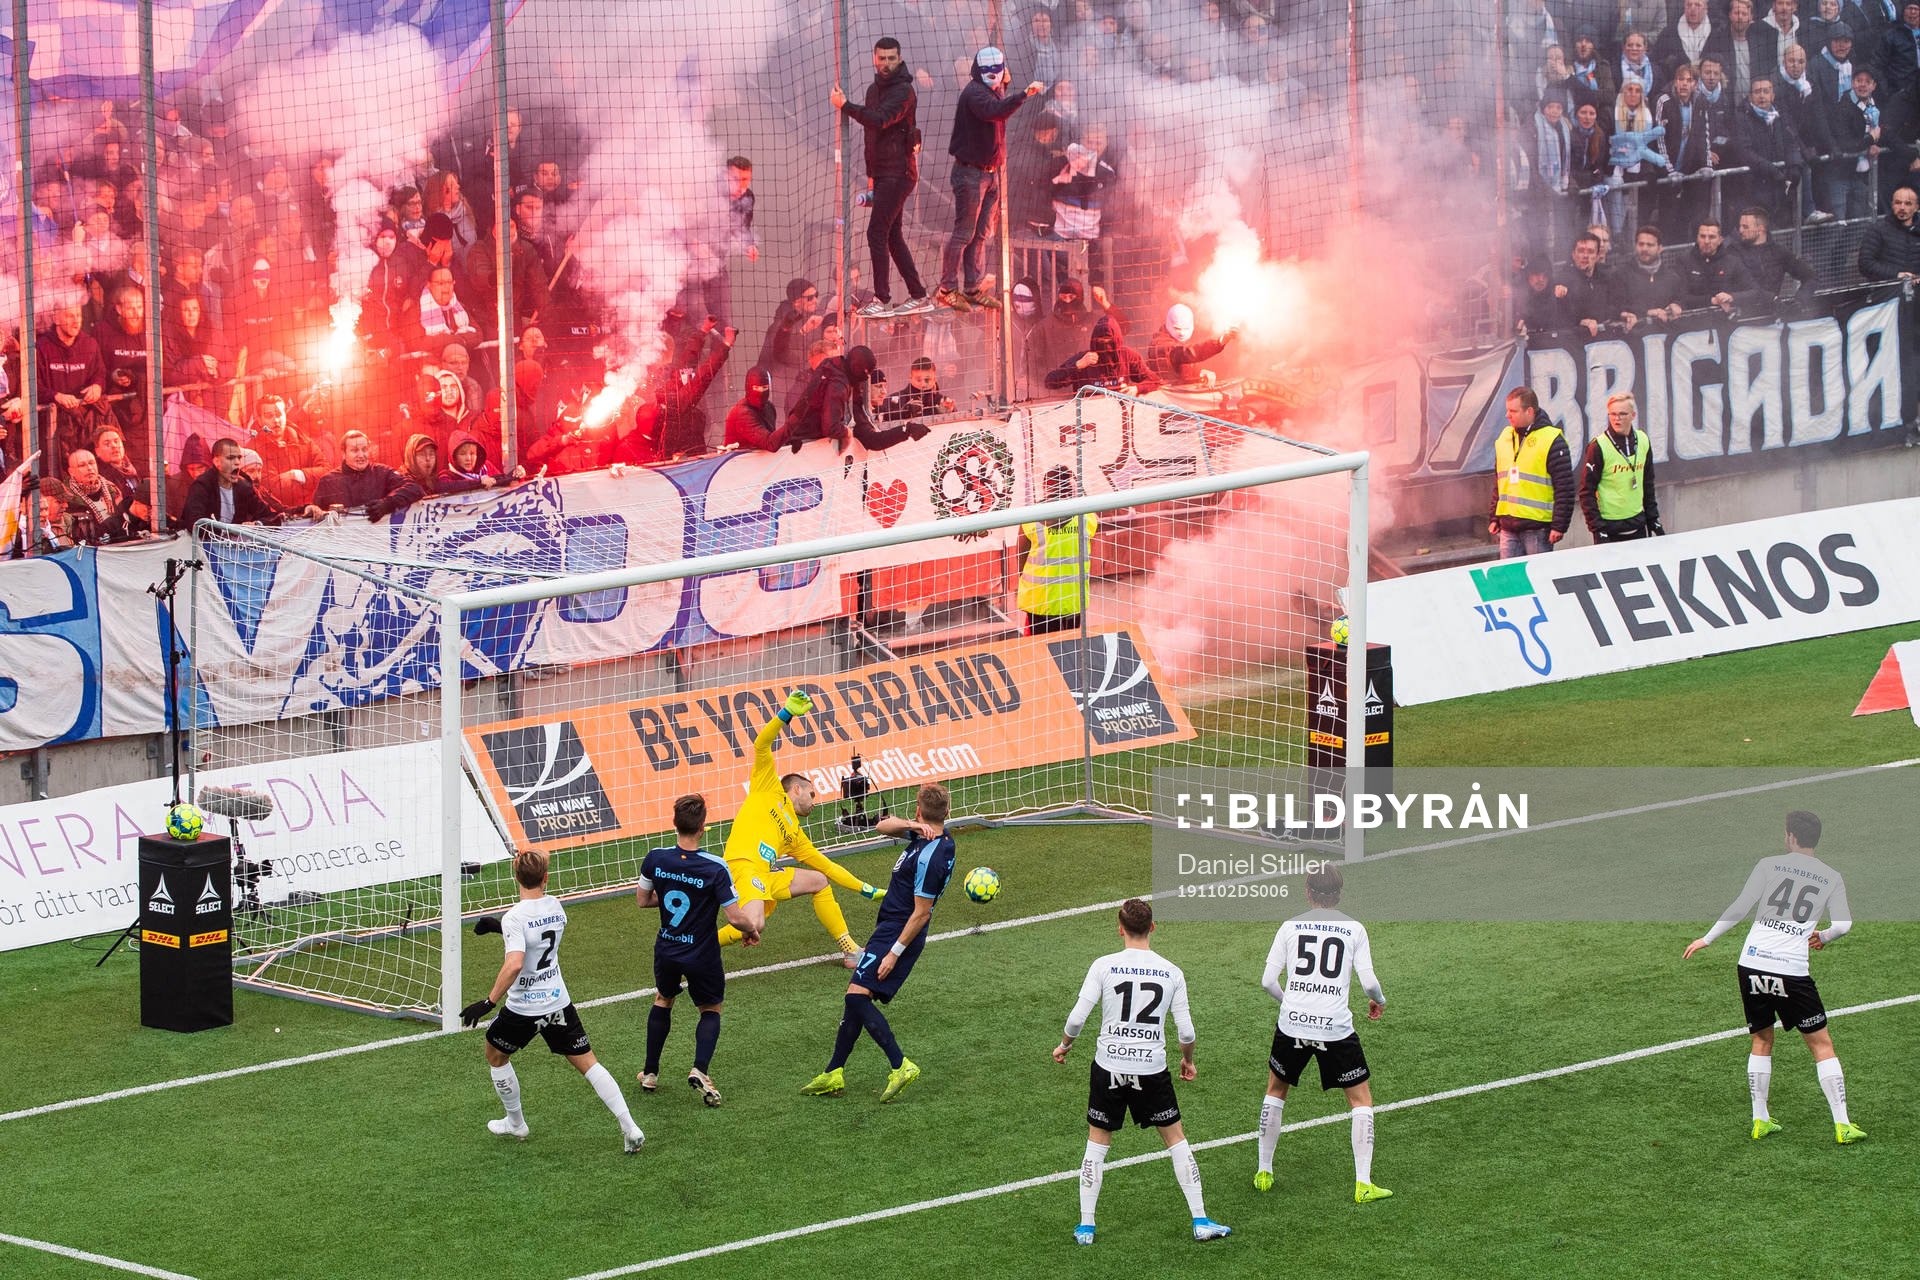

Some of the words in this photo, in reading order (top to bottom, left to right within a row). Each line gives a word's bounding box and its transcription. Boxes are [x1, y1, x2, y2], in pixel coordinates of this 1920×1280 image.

[1528, 297, 1904, 472] BRIGADA
[1552, 533, 1880, 647] TEKNOS
[629, 702, 713, 773] BE
[697, 681, 852, 759] YOUR
[835, 652, 1021, 739] BRAND
[1094, 706, 1120, 721] NEW
[1119, 702, 1153, 717] WAVE
[1316, 704, 1339, 716] SELECT
[1365, 704, 1384, 717] ELECT
[1101, 714, 1161, 735] PROFILE
[1314, 734, 1338, 745] DHL
[1365, 735, 1384, 745] HL
[180, 769, 387, 838] EDIA
[529, 799, 560, 818] NEW
[560, 796, 595, 812] WAVE
[536, 809, 602, 833] PROFILE
[33, 890, 87, 919] ditt
[86, 883, 139, 909] var
[267, 839, 406, 885] xponera.se
[654, 867, 704, 889] Rosenberg
[1773, 864, 1829, 885] MALMBERGS
[148, 900, 175, 915] SELECT
[195, 900, 222, 915] SELECT
[663, 889, 691, 928] 9
[1767, 877, 1820, 924] 46
[147, 932, 175, 945] DHL
[194, 932, 222, 945] DHL
[1294, 923, 1352, 937] MALMBERGS
[535, 930, 557, 972] 2
[1294, 934, 1345, 979] 50
[1110, 967, 1170, 979] MALMBERGS
[1289, 981, 1342, 997] BERGMARK
[1749, 974, 1789, 998] NA
[1113, 980, 1164, 1025] 12
[1288, 1011, 1334, 1026] GÖRTZ
[1107, 1025, 1160, 1041] LARSSON
[1107, 1044, 1153, 1059] GÖRTZ
